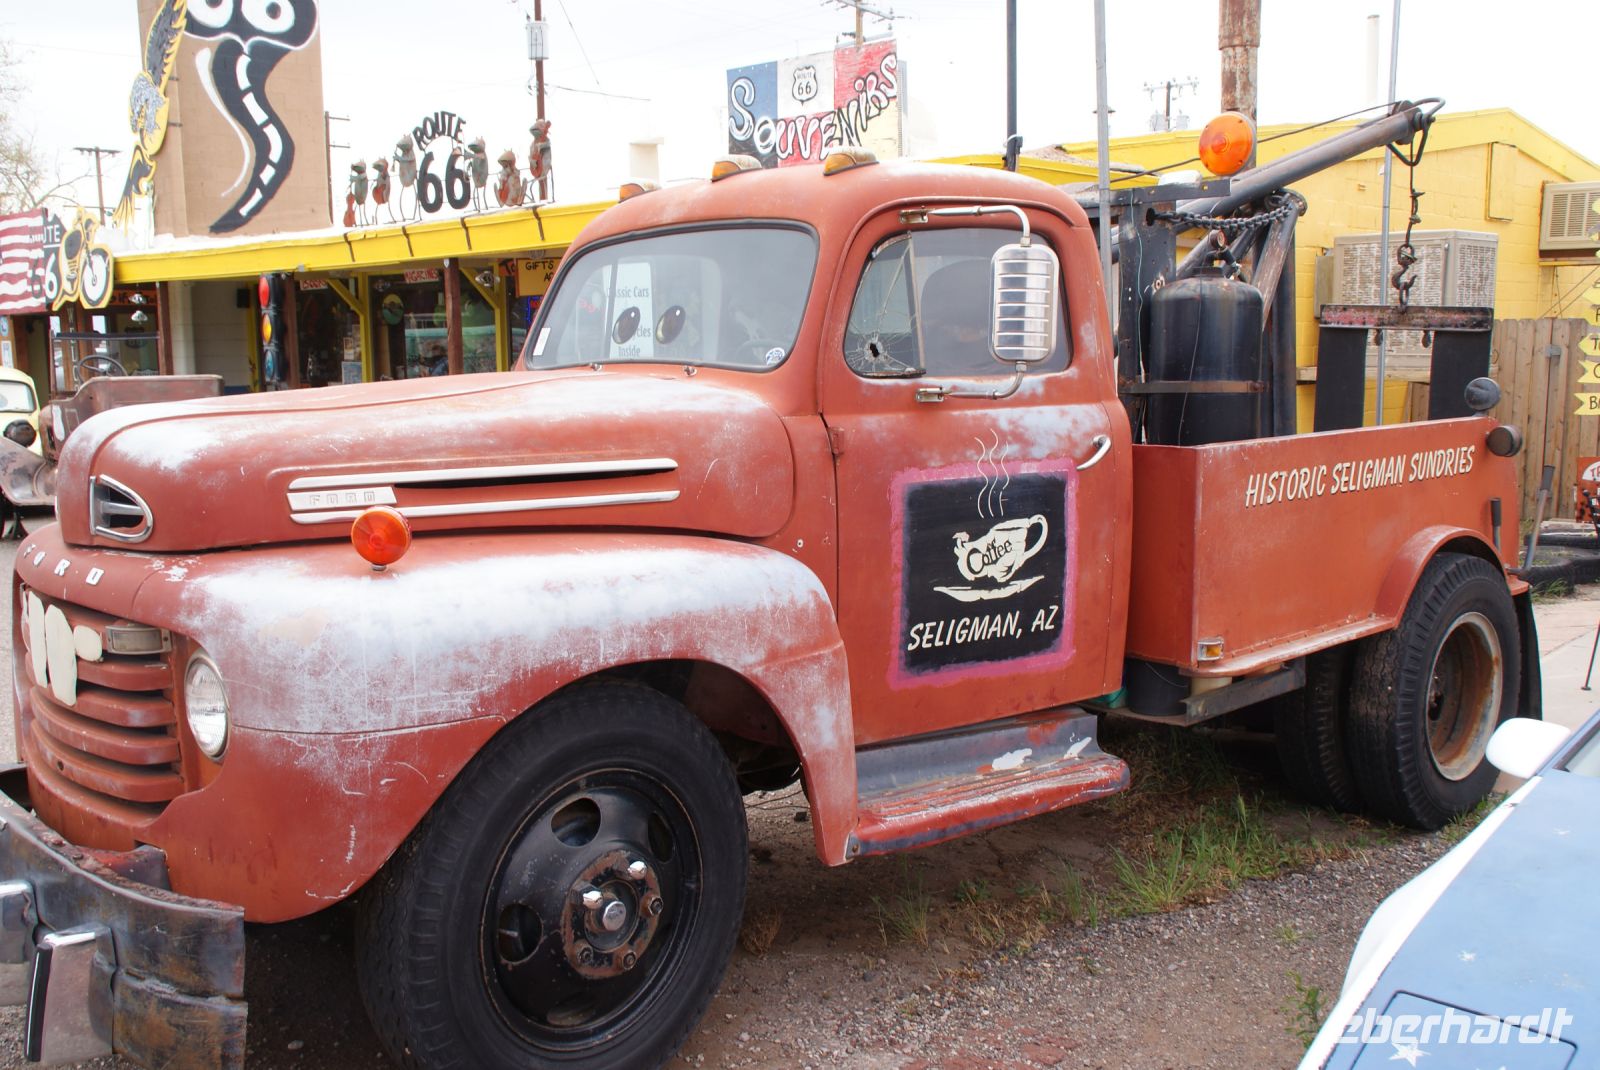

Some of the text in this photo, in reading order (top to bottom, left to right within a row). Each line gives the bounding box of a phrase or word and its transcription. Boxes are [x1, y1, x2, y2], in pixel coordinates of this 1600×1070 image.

[797, 80, 812, 96] 66
[412, 110, 466, 151] ROUTE
[416, 150, 471, 214] 66
[525, 260, 554, 271] GIFTS
[633, 286, 650, 298] Cars
[1245, 445, 1476, 508] HISTORIC SELIGMAN SUNDRIES
[309, 491, 376, 506] FORD
[23, 543, 105, 586] FORD
[965, 536, 1014, 576] Coffee
[907, 605, 1060, 652] SELIGMAN, AZ
